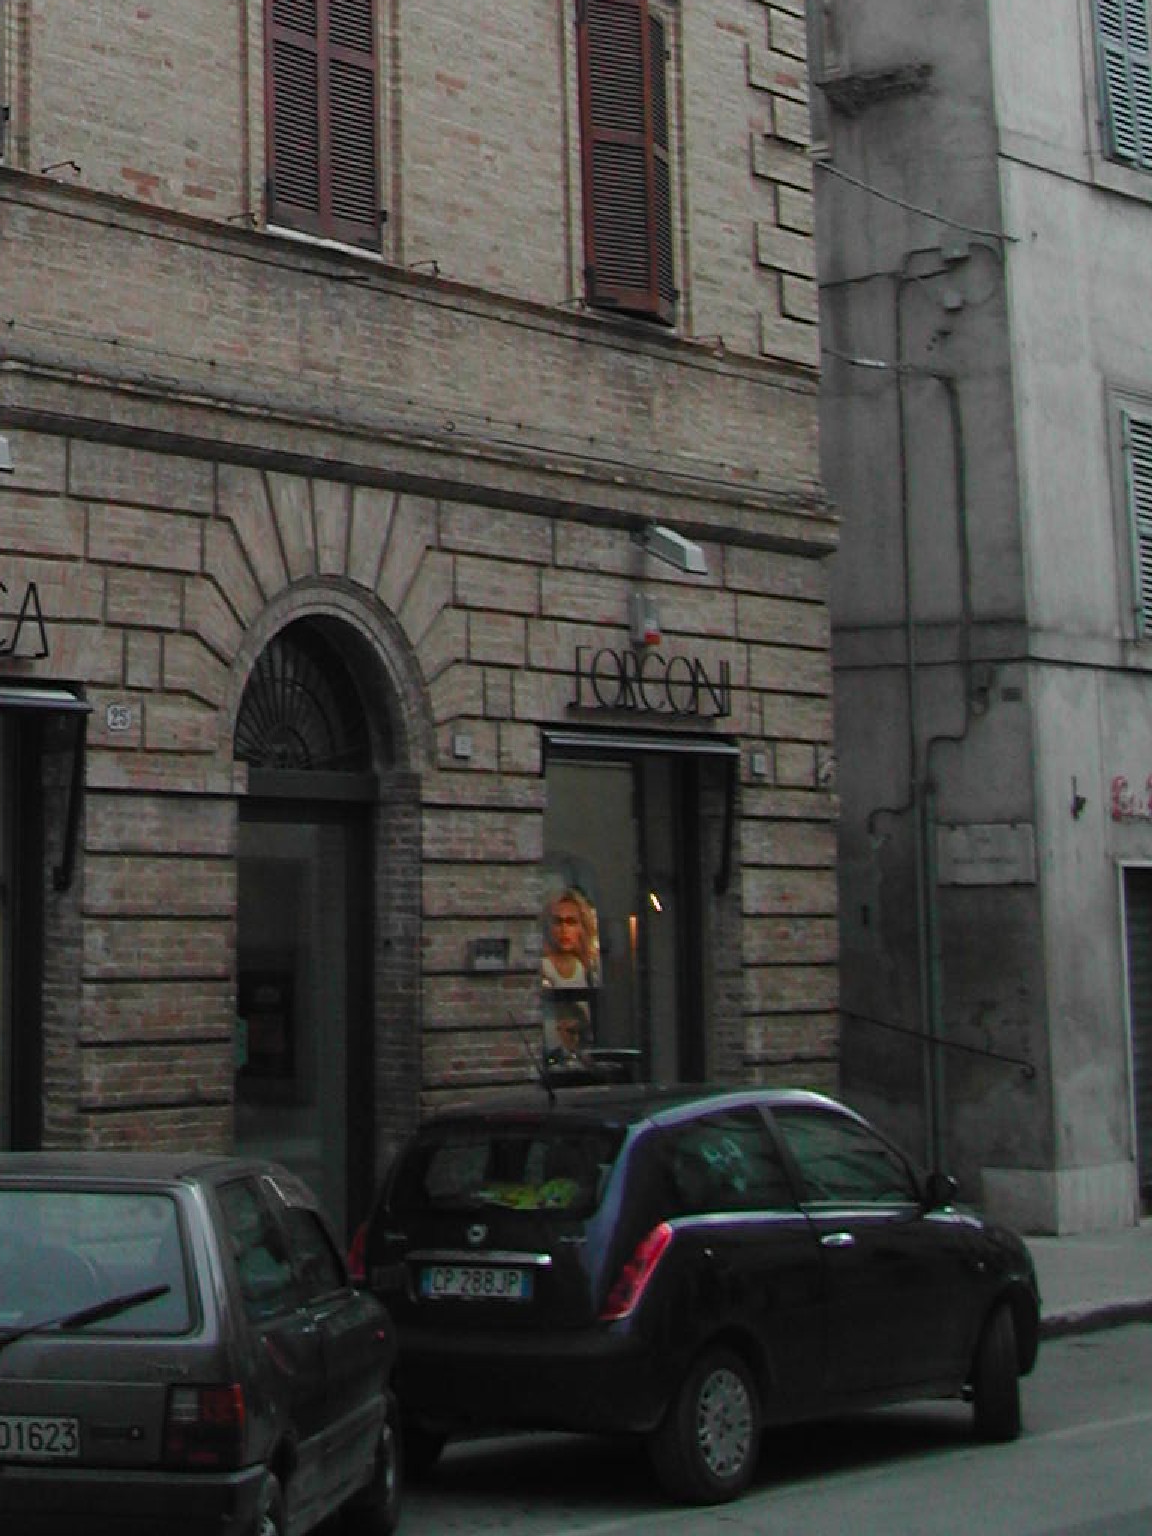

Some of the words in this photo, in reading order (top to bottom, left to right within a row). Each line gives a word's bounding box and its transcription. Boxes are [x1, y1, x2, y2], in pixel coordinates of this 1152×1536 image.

[572, 644, 731, 716] FORCONI
[110, 707, 129, 727] 25
[433, 1268, 454, 1292] CP
